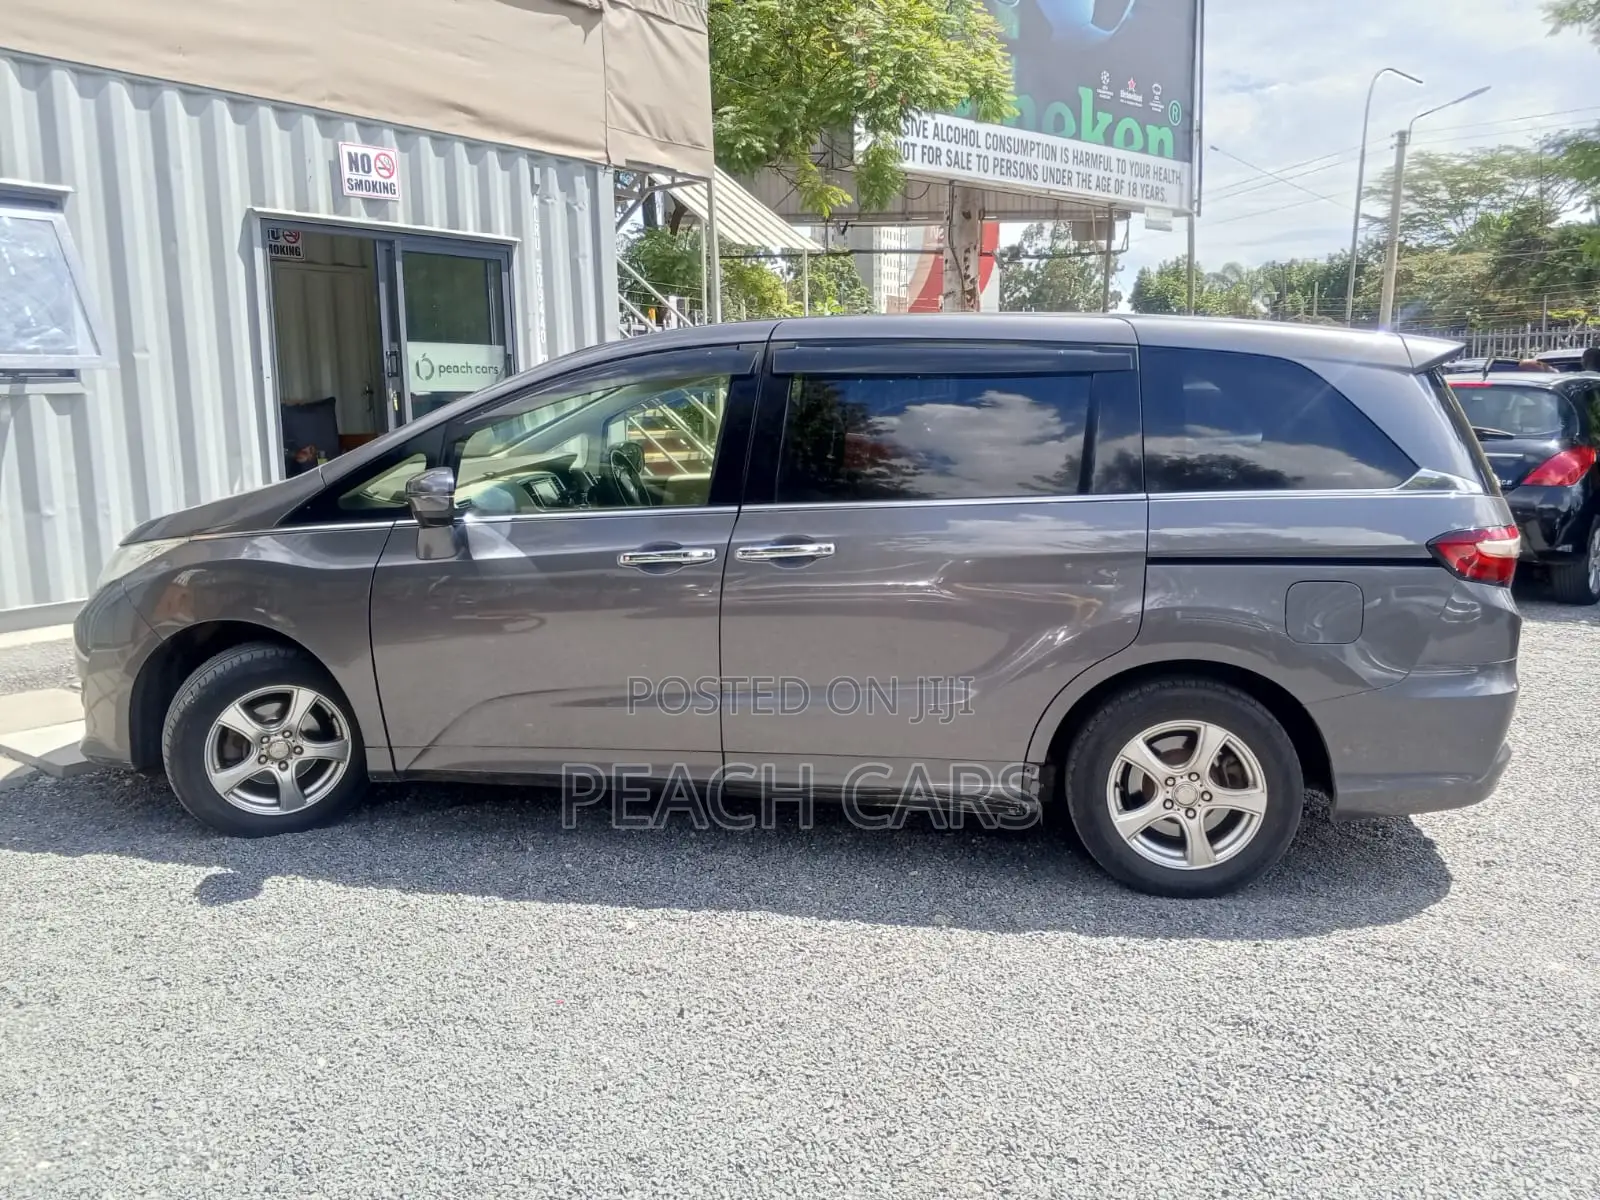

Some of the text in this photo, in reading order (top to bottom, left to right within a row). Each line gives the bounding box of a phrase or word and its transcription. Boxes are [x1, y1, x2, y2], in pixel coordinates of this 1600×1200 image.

[347, 151, 372, 174] NO
[902, 119, 1184, 187] SIVE ALCOHOL CONSUMPTION IS HARMFUL TO YOUR HEALTH.
[920, 145, 942, 167] FOR
[945, 149, 973, 171] SALE
[976, 154, 989, 174] TO
[992, 157, 1039, 181] PERSONS
[1042, 165, 1073, 188] UNDER
[1076, 171, 1093, 190] THE
[1095, 175, 1112, 194] AGE
[1114, 178, 1126, 195] OF
[1128, 181, 1138, 198] 18
[1140, 183, 1169, 203] YEARS.
[346, 178, 397, 196] SMOKING
[438, 361, 499, 376] peach cars
